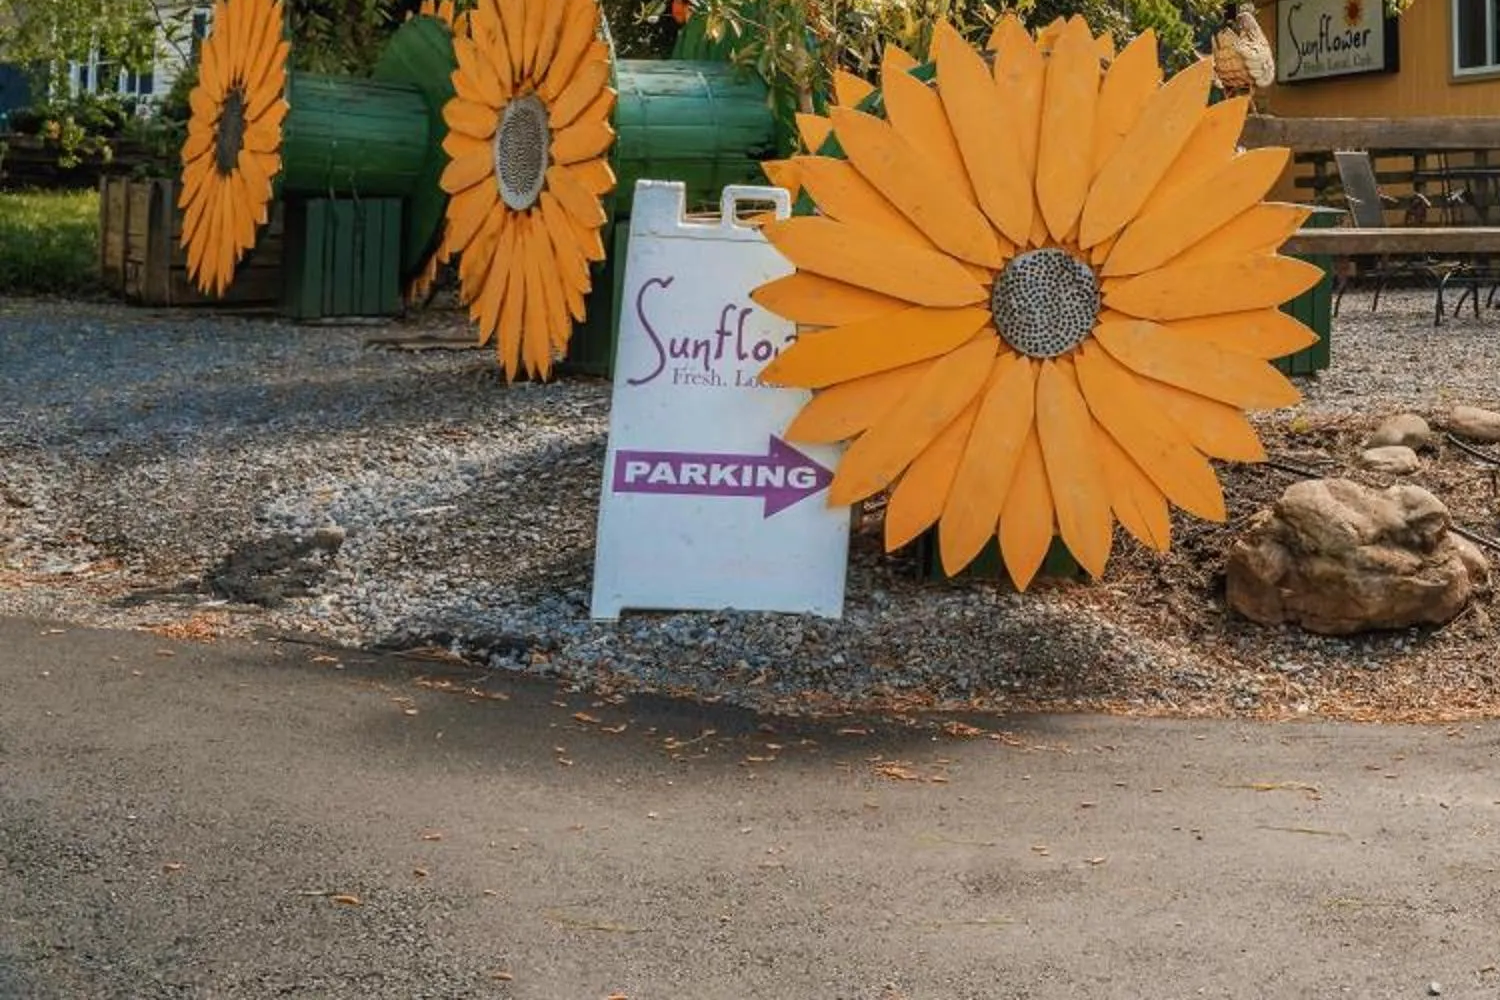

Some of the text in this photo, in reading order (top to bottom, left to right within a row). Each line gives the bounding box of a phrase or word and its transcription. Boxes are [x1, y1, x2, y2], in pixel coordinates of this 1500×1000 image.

[1287, 2, 1372, 78] Sunflower
[627, 276, 798, 386] Sunflo
[672, 367, 728, 386] Fresh.
[624, 461, 818, 489] PARKING
